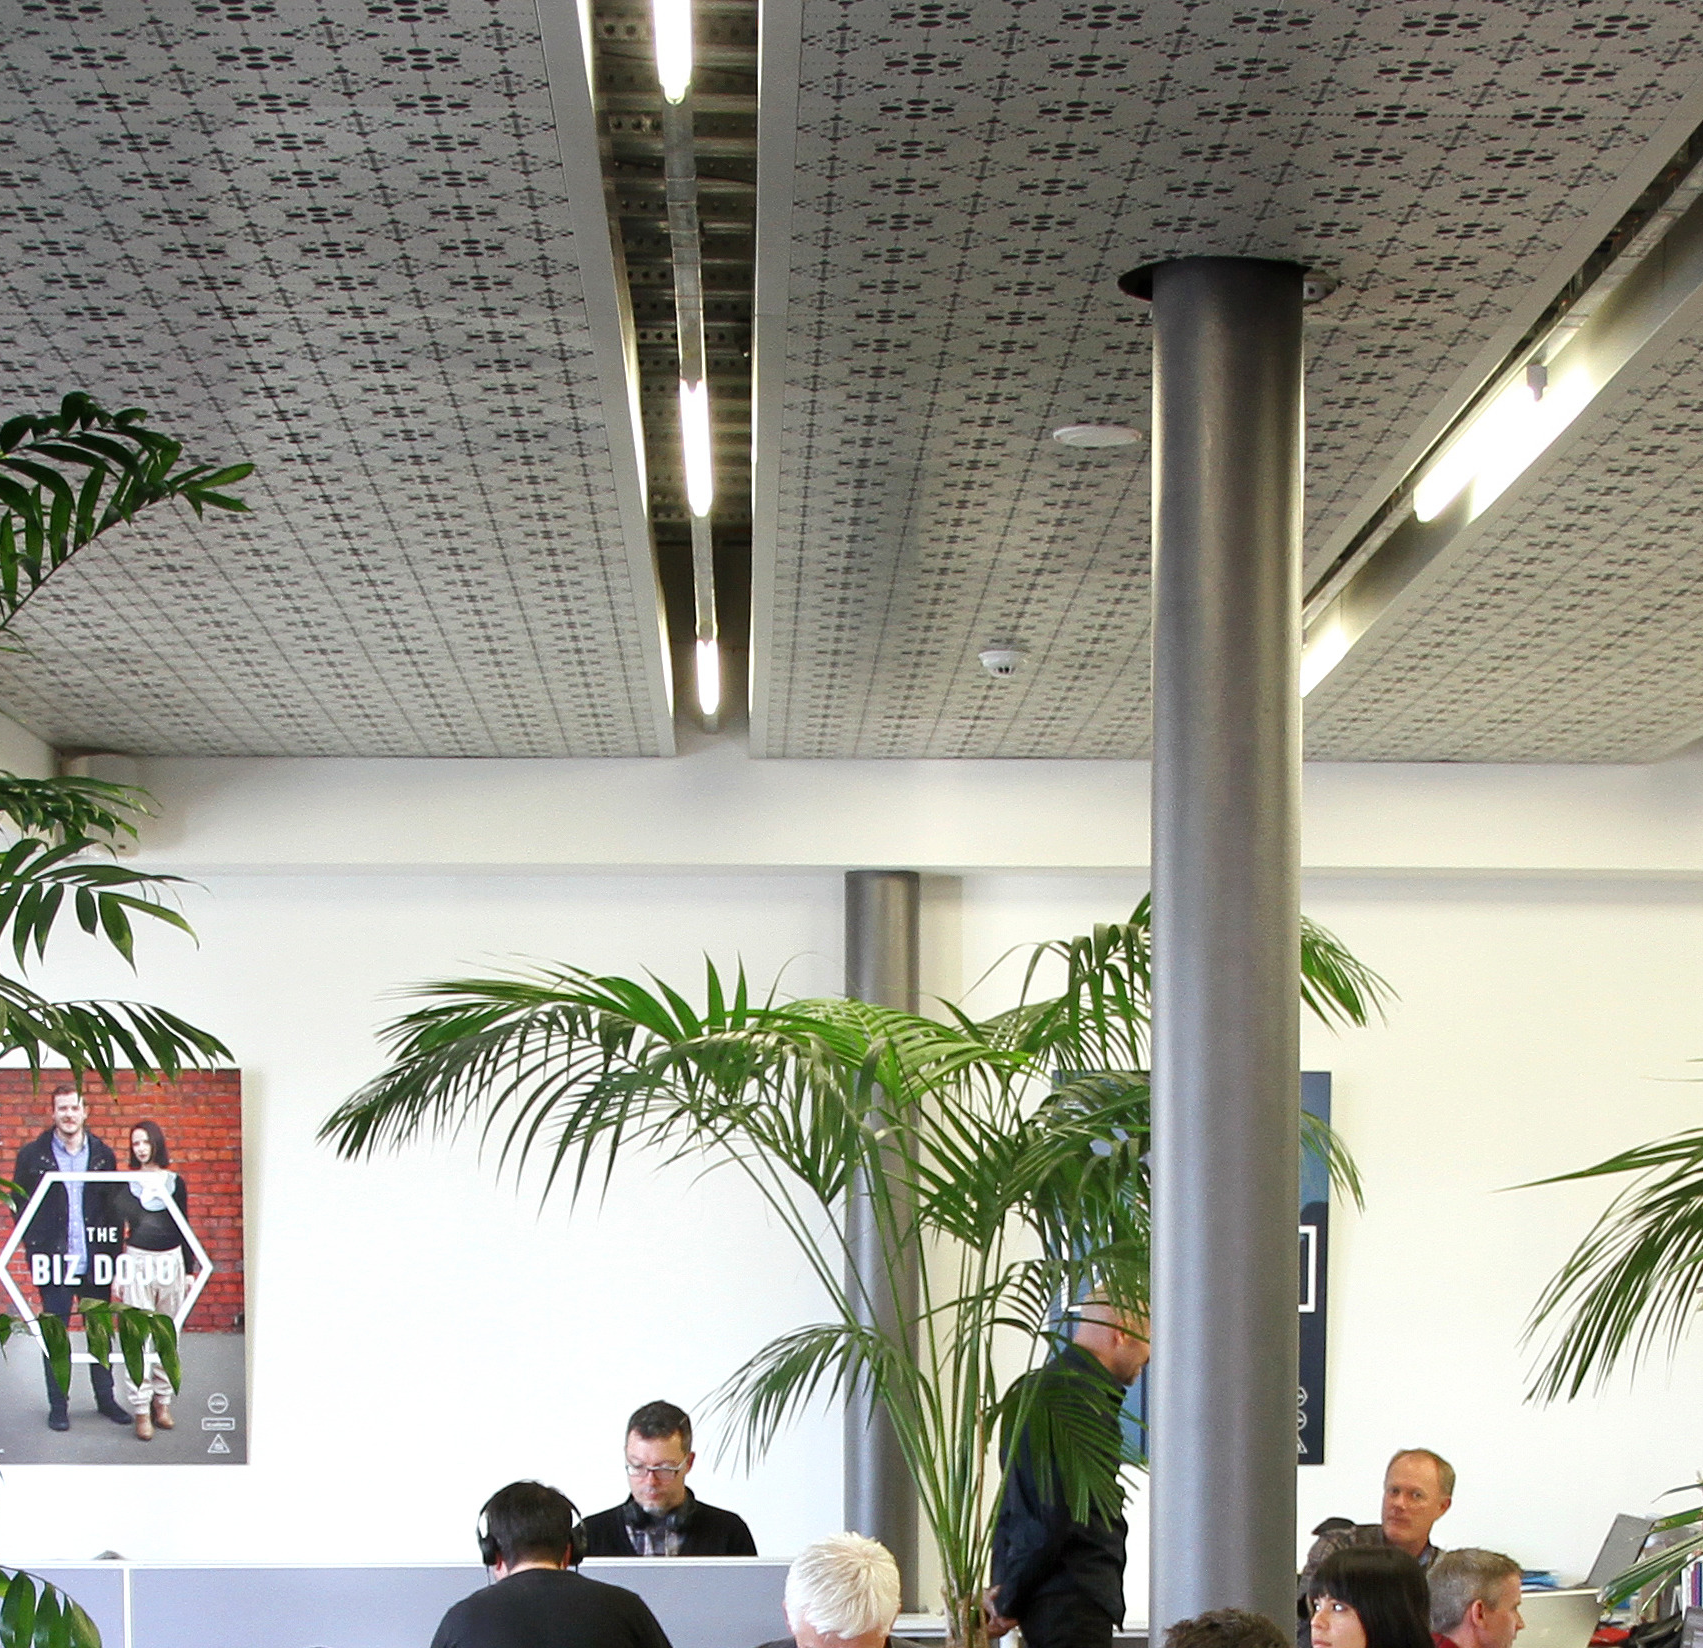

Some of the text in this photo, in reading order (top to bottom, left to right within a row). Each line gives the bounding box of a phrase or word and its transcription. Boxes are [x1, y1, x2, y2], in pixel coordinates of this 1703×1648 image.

[86, 1226, 118, 1243] THE
[31, 1253, 176, 1286] BIZ DOJO
